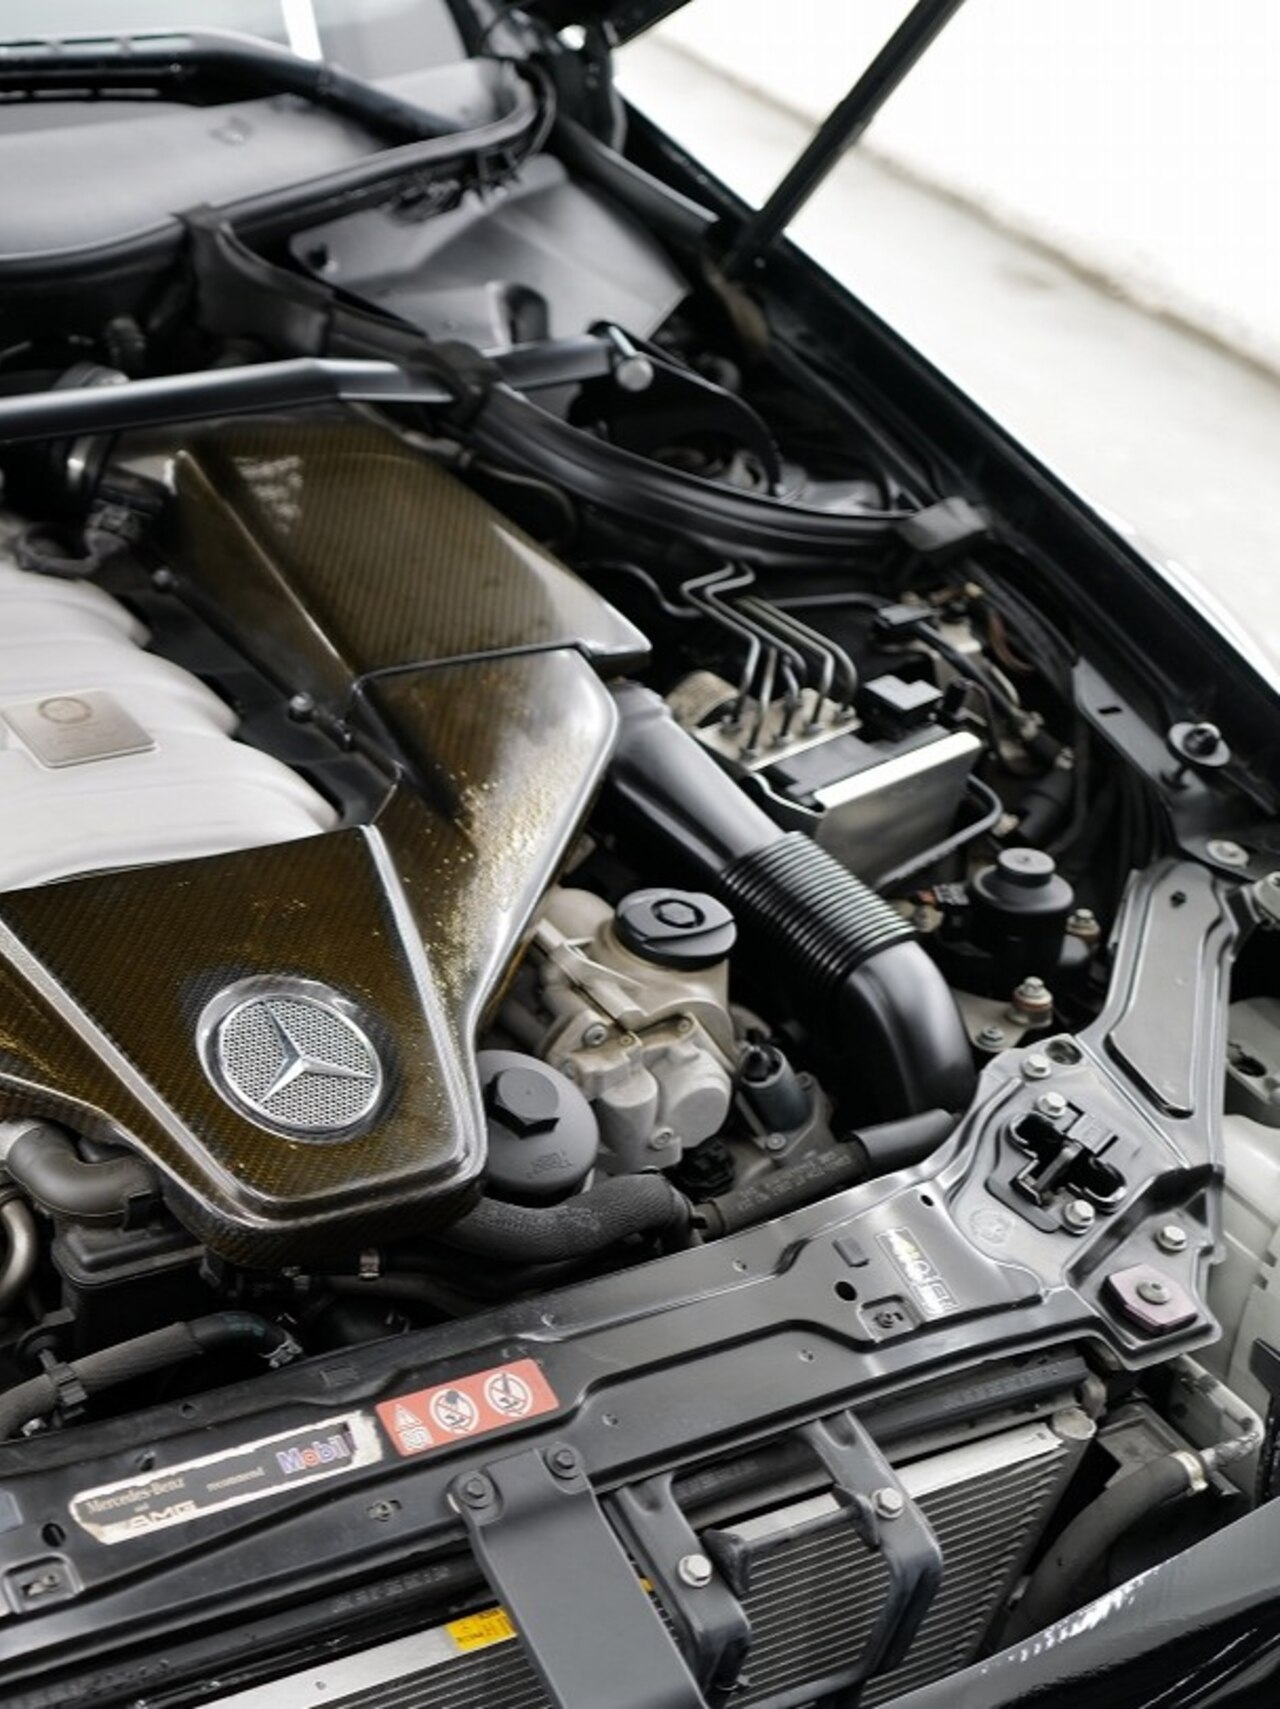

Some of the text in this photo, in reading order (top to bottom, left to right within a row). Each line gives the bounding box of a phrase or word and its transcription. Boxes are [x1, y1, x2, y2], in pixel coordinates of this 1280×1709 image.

[276, 1434, 352, 1474] Mobil
[86, 1478, 185, 1513] Mercedes-Benz
[129, 1499, 198, 1529] AMG
